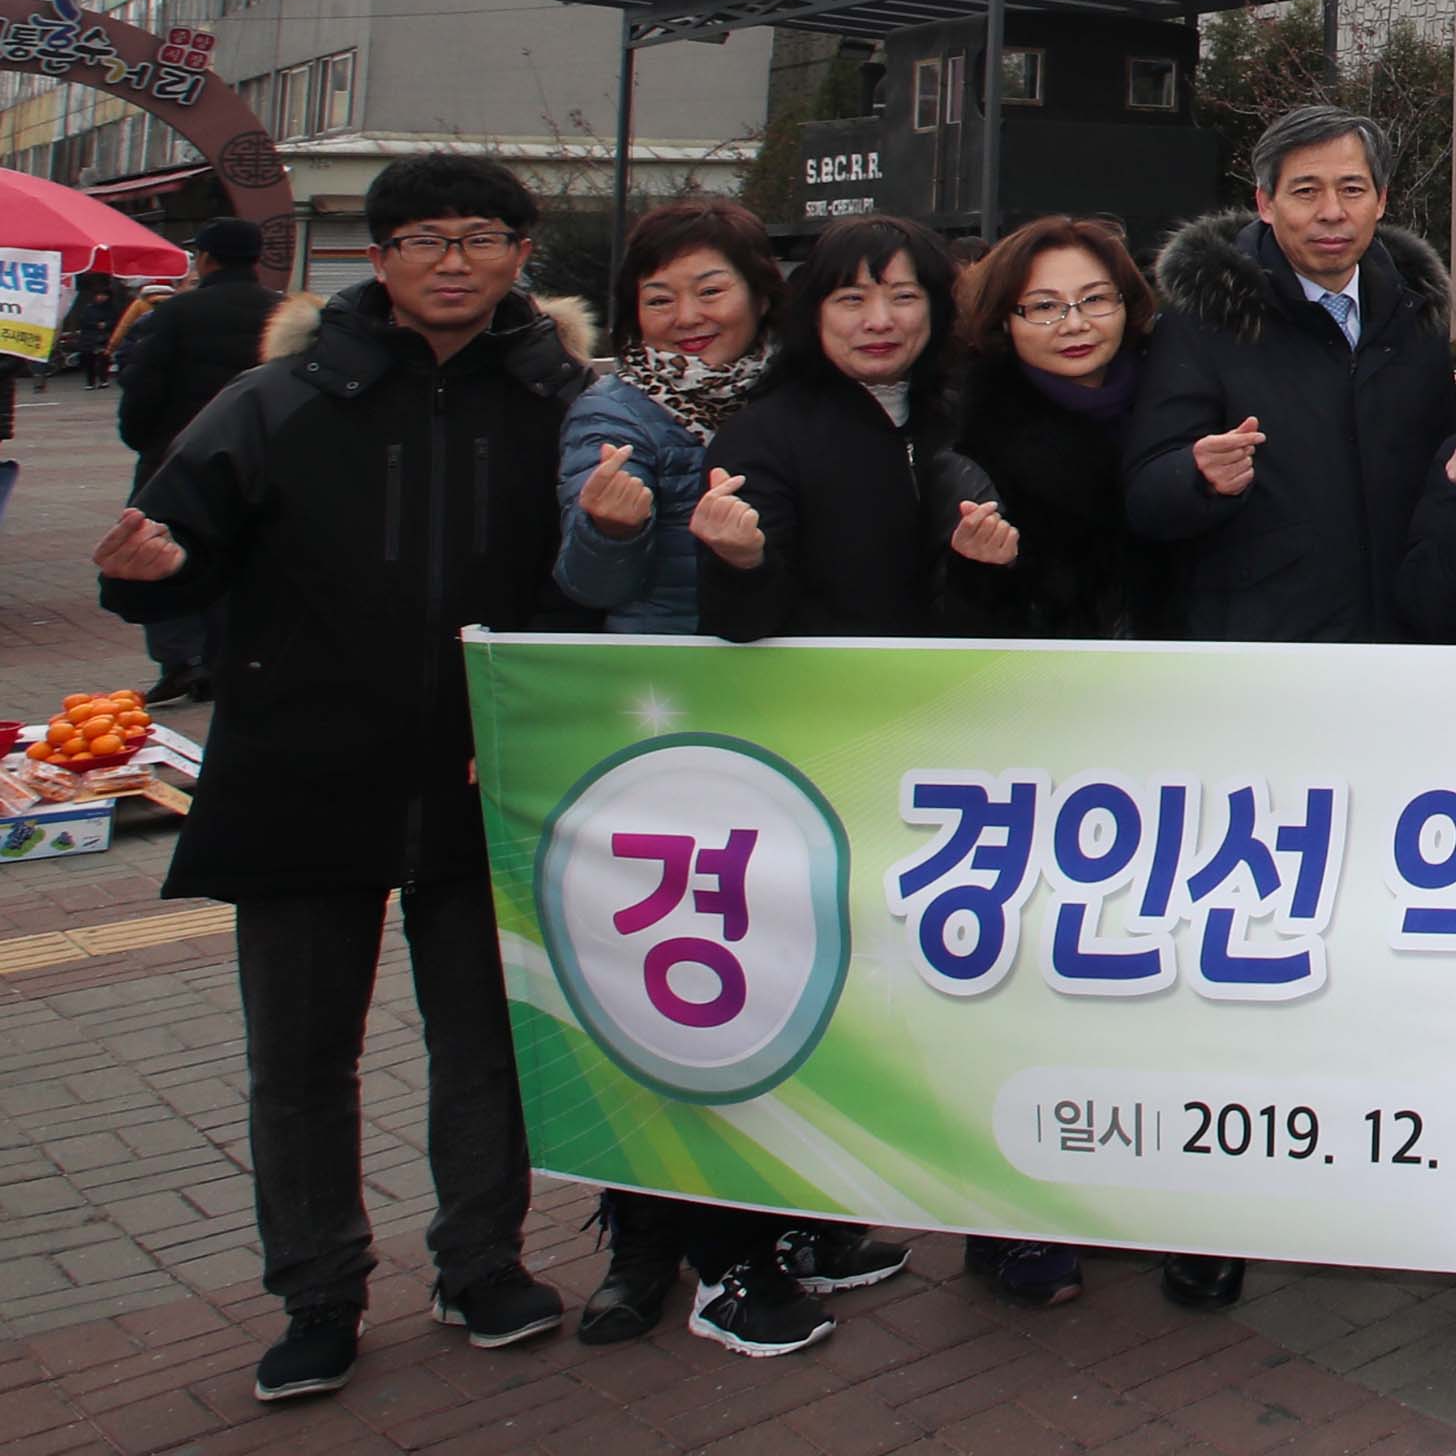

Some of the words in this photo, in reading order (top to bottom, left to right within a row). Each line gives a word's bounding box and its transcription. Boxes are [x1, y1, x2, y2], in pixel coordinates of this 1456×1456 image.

[611, 828, 759, 1028] 경
[898, 782, 1334, 986] 경인선
[1053, 1100, 1144, 1156] 일시
[1182, 1101, 1334, 1165] 2019.
[1363, 1109, 1438, 1169] 12.
